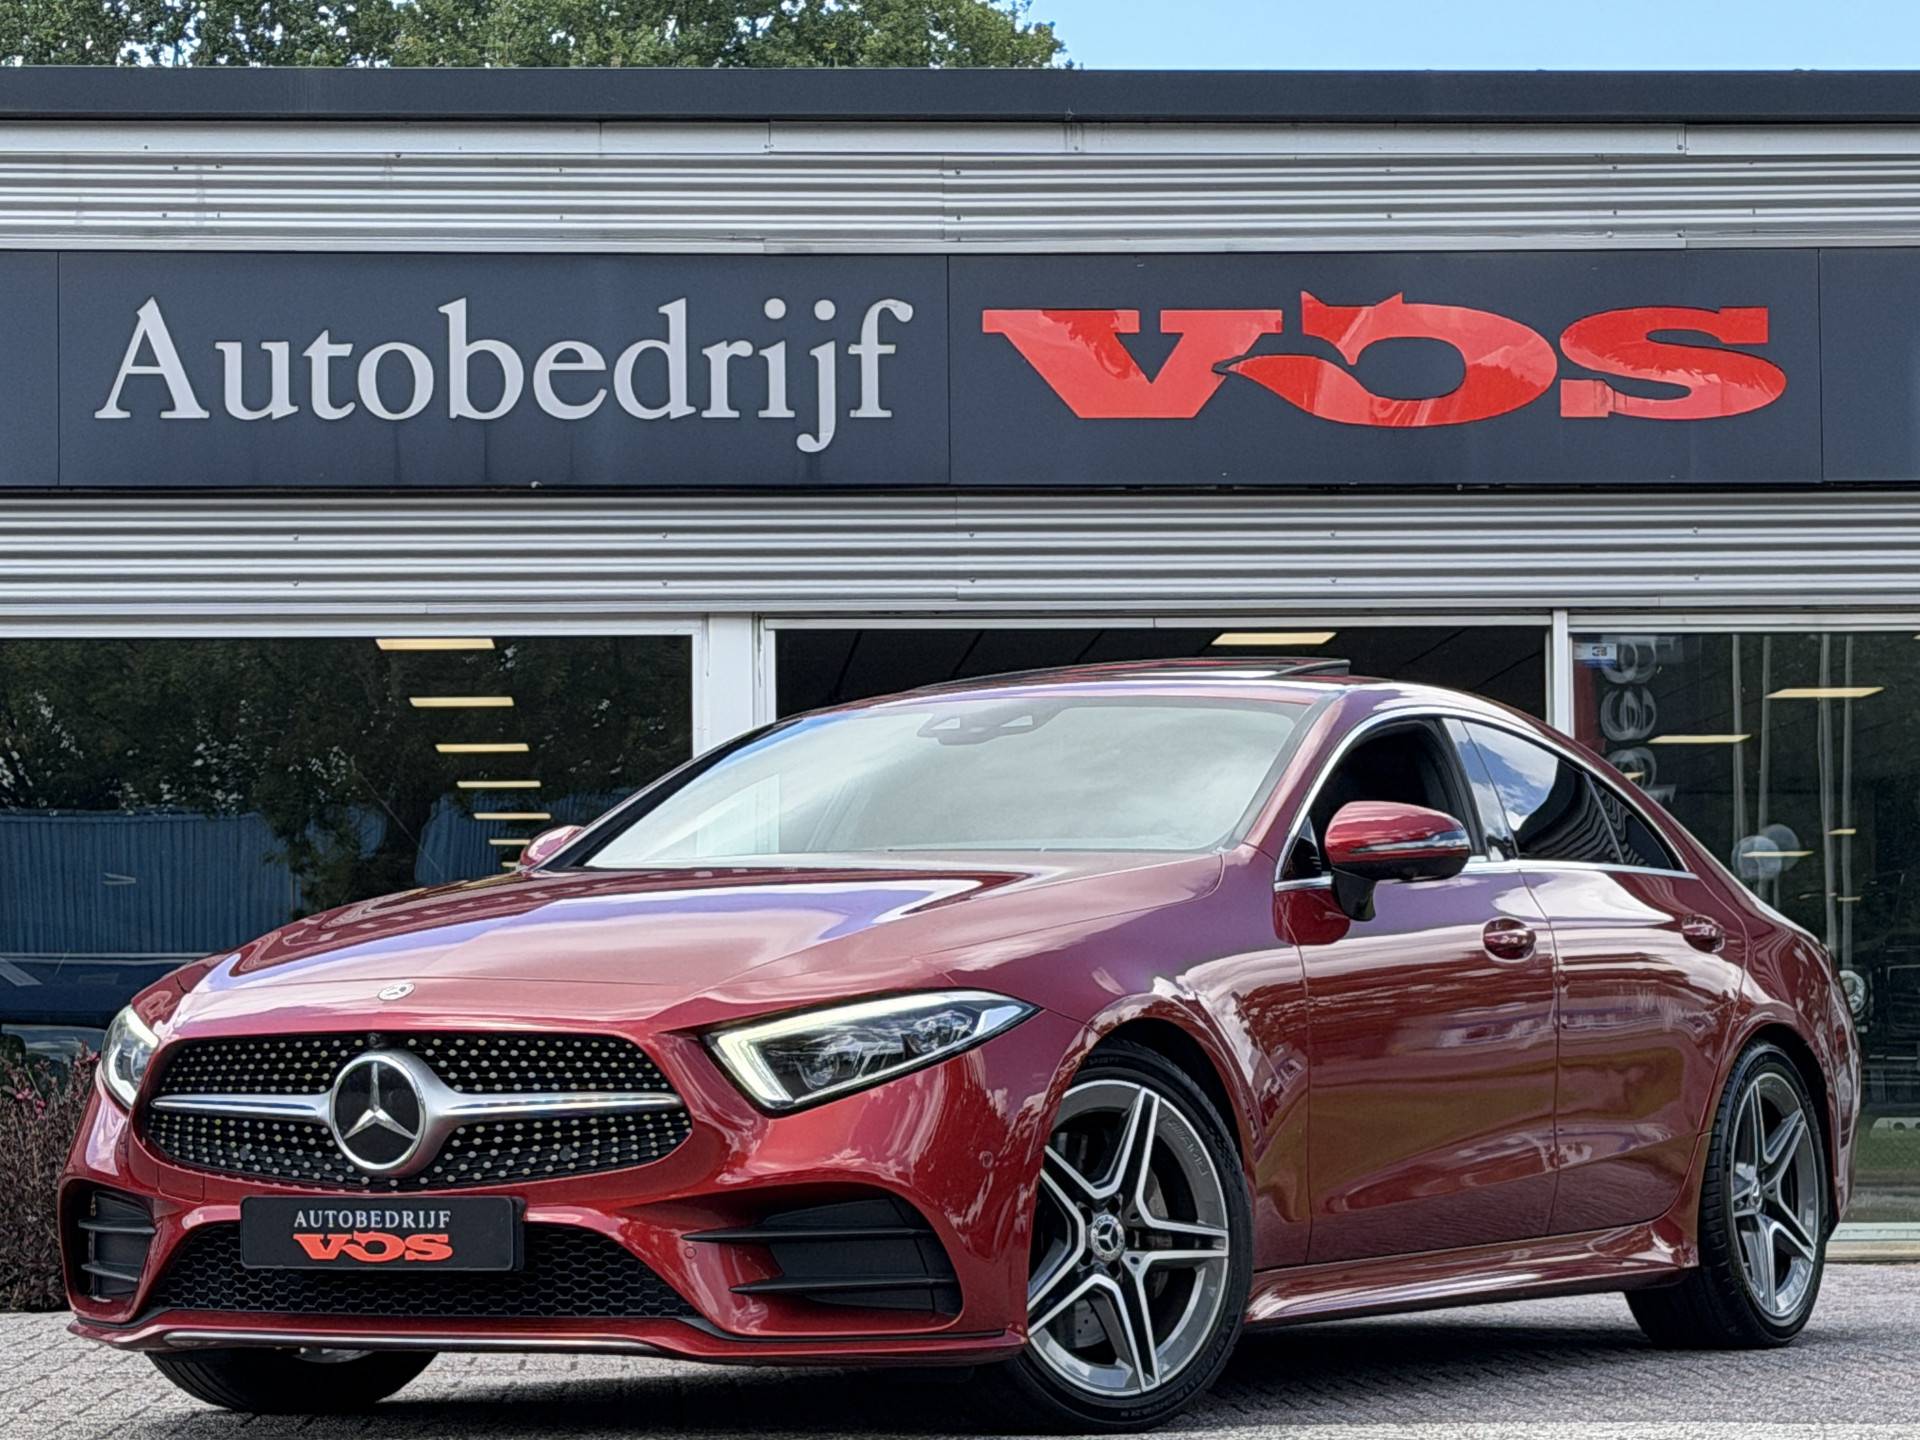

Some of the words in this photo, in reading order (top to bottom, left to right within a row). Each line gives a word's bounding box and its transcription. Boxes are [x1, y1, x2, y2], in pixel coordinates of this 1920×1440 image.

[95, 297, 914, 453] Autobedrijf
[983, 291, 1787, 428] VOS
[294, 1210, 451, 1228] AUTOBEDRIJF
[293, 1231, 453, 1262] VOS
